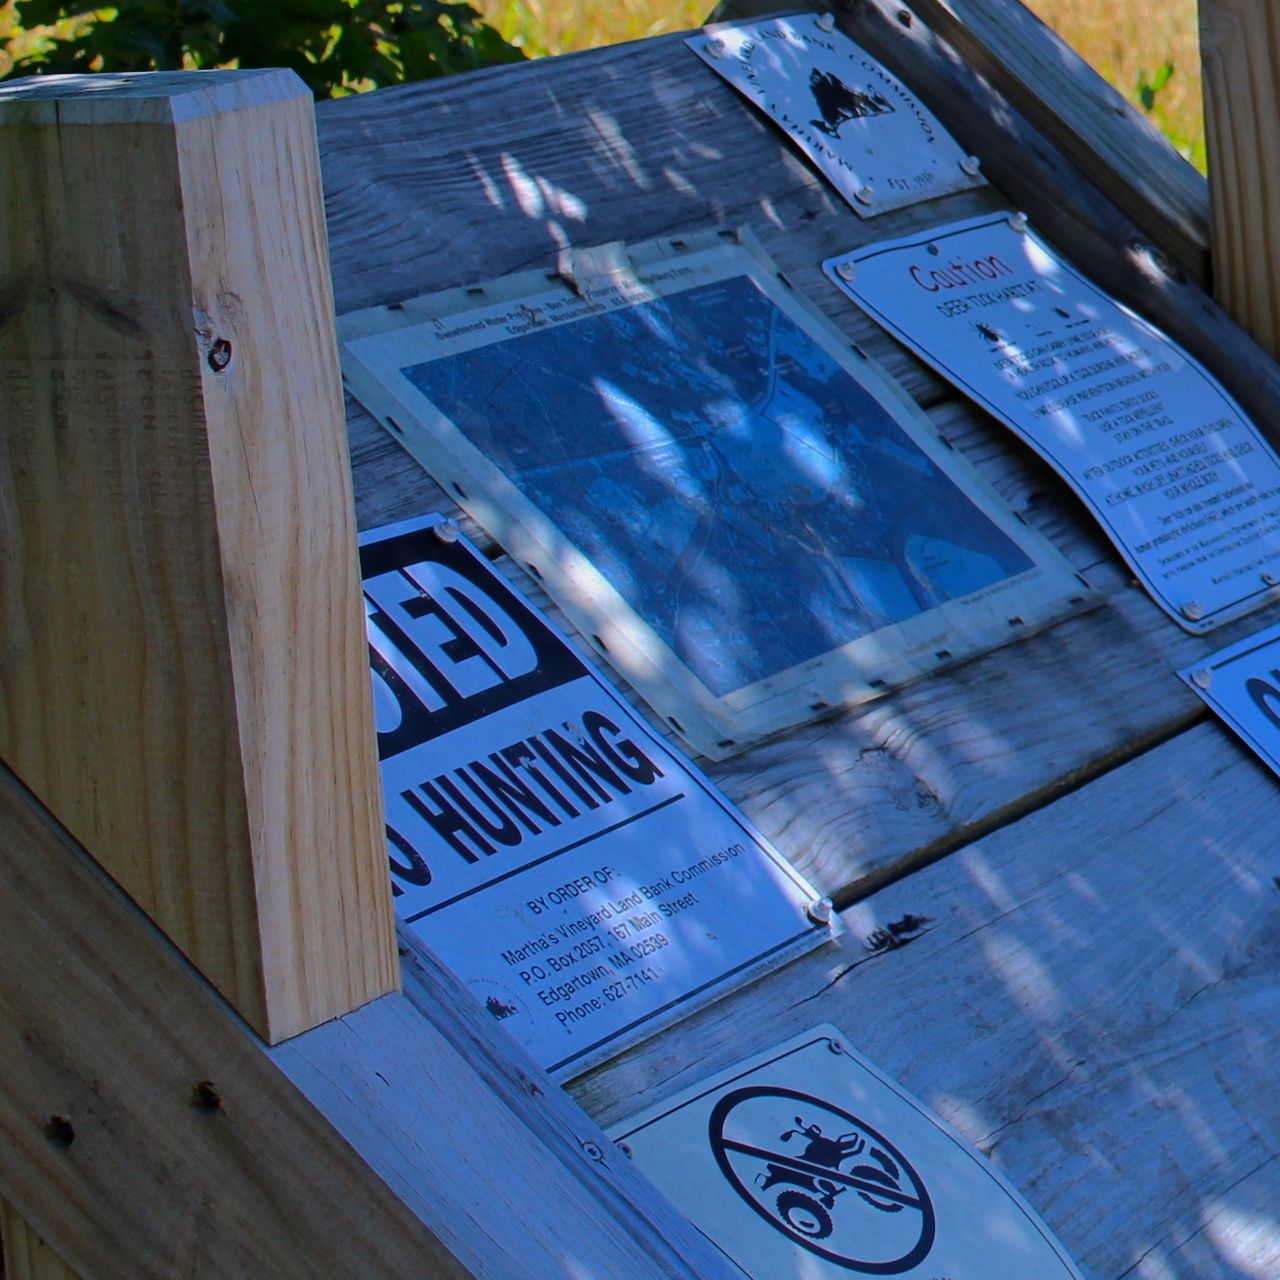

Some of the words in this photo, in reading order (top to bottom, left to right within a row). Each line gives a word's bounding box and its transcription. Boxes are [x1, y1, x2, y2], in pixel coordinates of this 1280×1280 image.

[753, 28, 787, 43] LAND
[848, 53, 937, 145] COMMISSION
[909, 256, 1012, 292] Caution
[936, 299, 972, 318] DEER
[965, 293, 998, 307] TICK
[992, 280, 1040, 303] HABITAT
[400, 711, 665, 864] HUNTING
[501, 934, 559, 966] Martha's
[558, 906, 612, 938] Vineyard
[608, 891, 643, 915] Land
[639, 878, 675, 900] Bank
[671, 844, 745, 884] Commission
[526, 896, 549, 915] BY
[548, 876, 598, 905] ORDER
[594, 866, 620, 884] OF:
[519, 966, 551, 986] P.O.
[547, 953, 578, 972] Box
[573, 936, 613, 959] 2057,
[608, 923, 631, 941] 167
[627, 912, 663, 932] Main
[658, 893, 699, 917] Street
[537, 966, 614, 1006] Edgartown,
[608, 951, 635, 970] MA
[630, 933, 669, 959] 02539
[555, 997, 606, 1027] Phone:
[602, 968, 658, 1002] 627-7141
